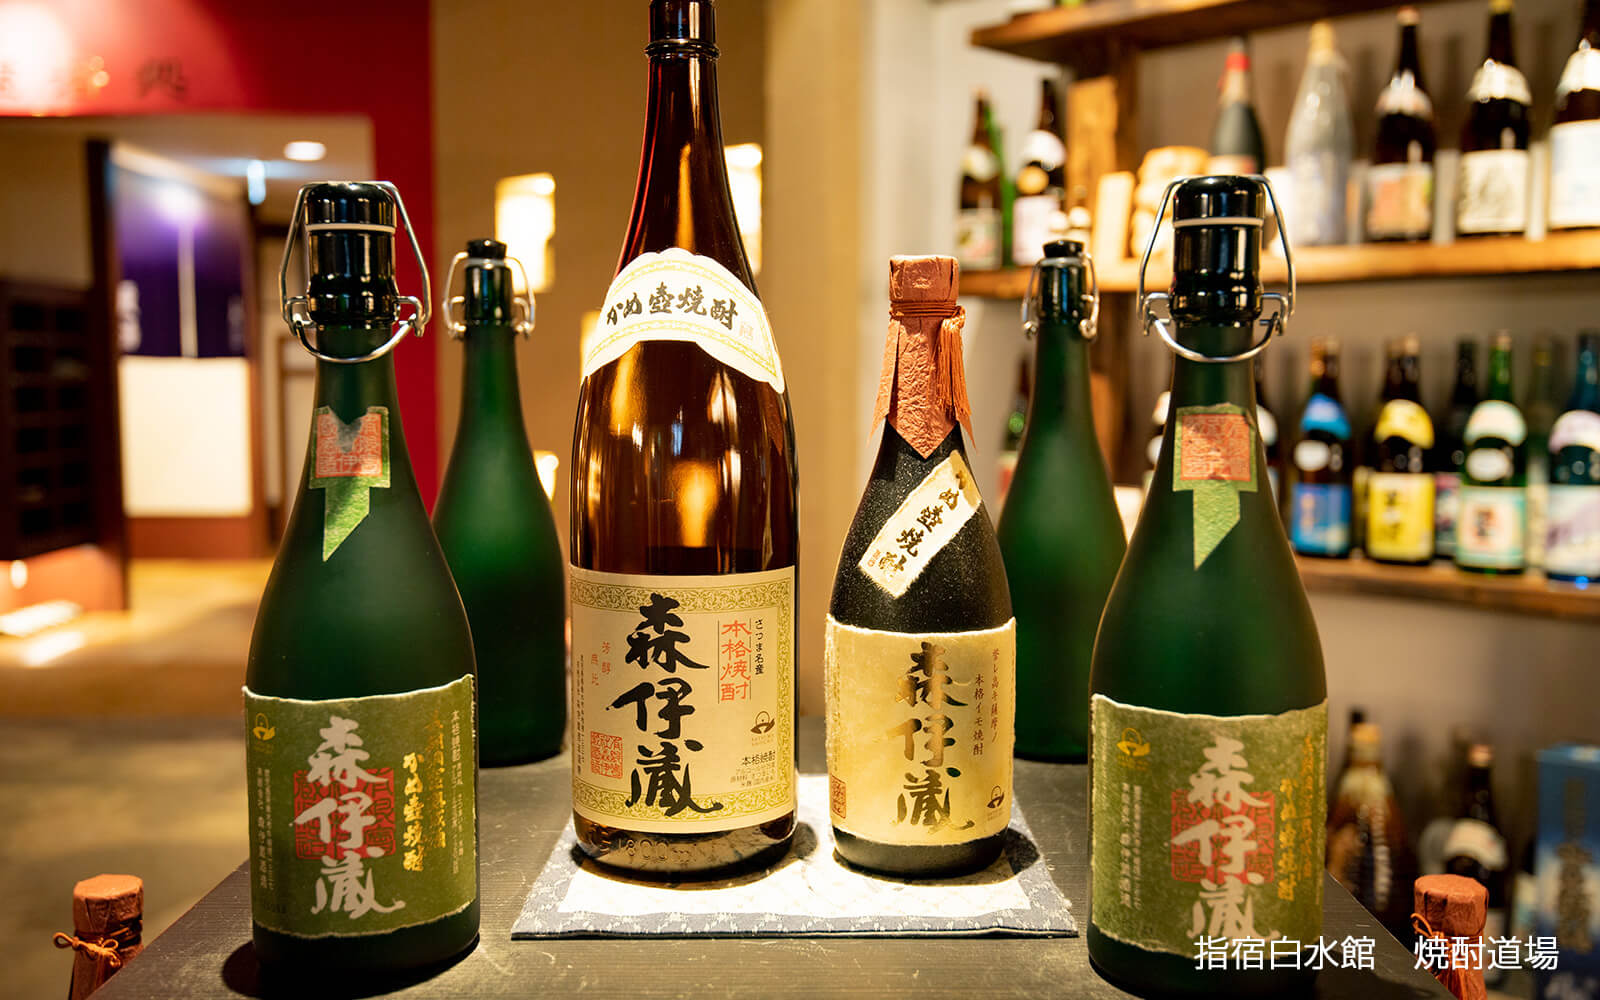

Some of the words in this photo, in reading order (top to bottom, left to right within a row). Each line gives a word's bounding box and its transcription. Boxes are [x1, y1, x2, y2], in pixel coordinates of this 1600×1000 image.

[606, 281, 739, 331] かめ壺焼酎
[605, 592, 724, 817] 森伊蔵
[719, 619, 753, 702] 本格焼酎
[754, 618, 765, 676] さつま名産
[873, 641, 975, 834] 森伊蔵
[289, 715, 406, 919] 森伊蔵
[1164, 735, 1281, 939] 森伊蔵
